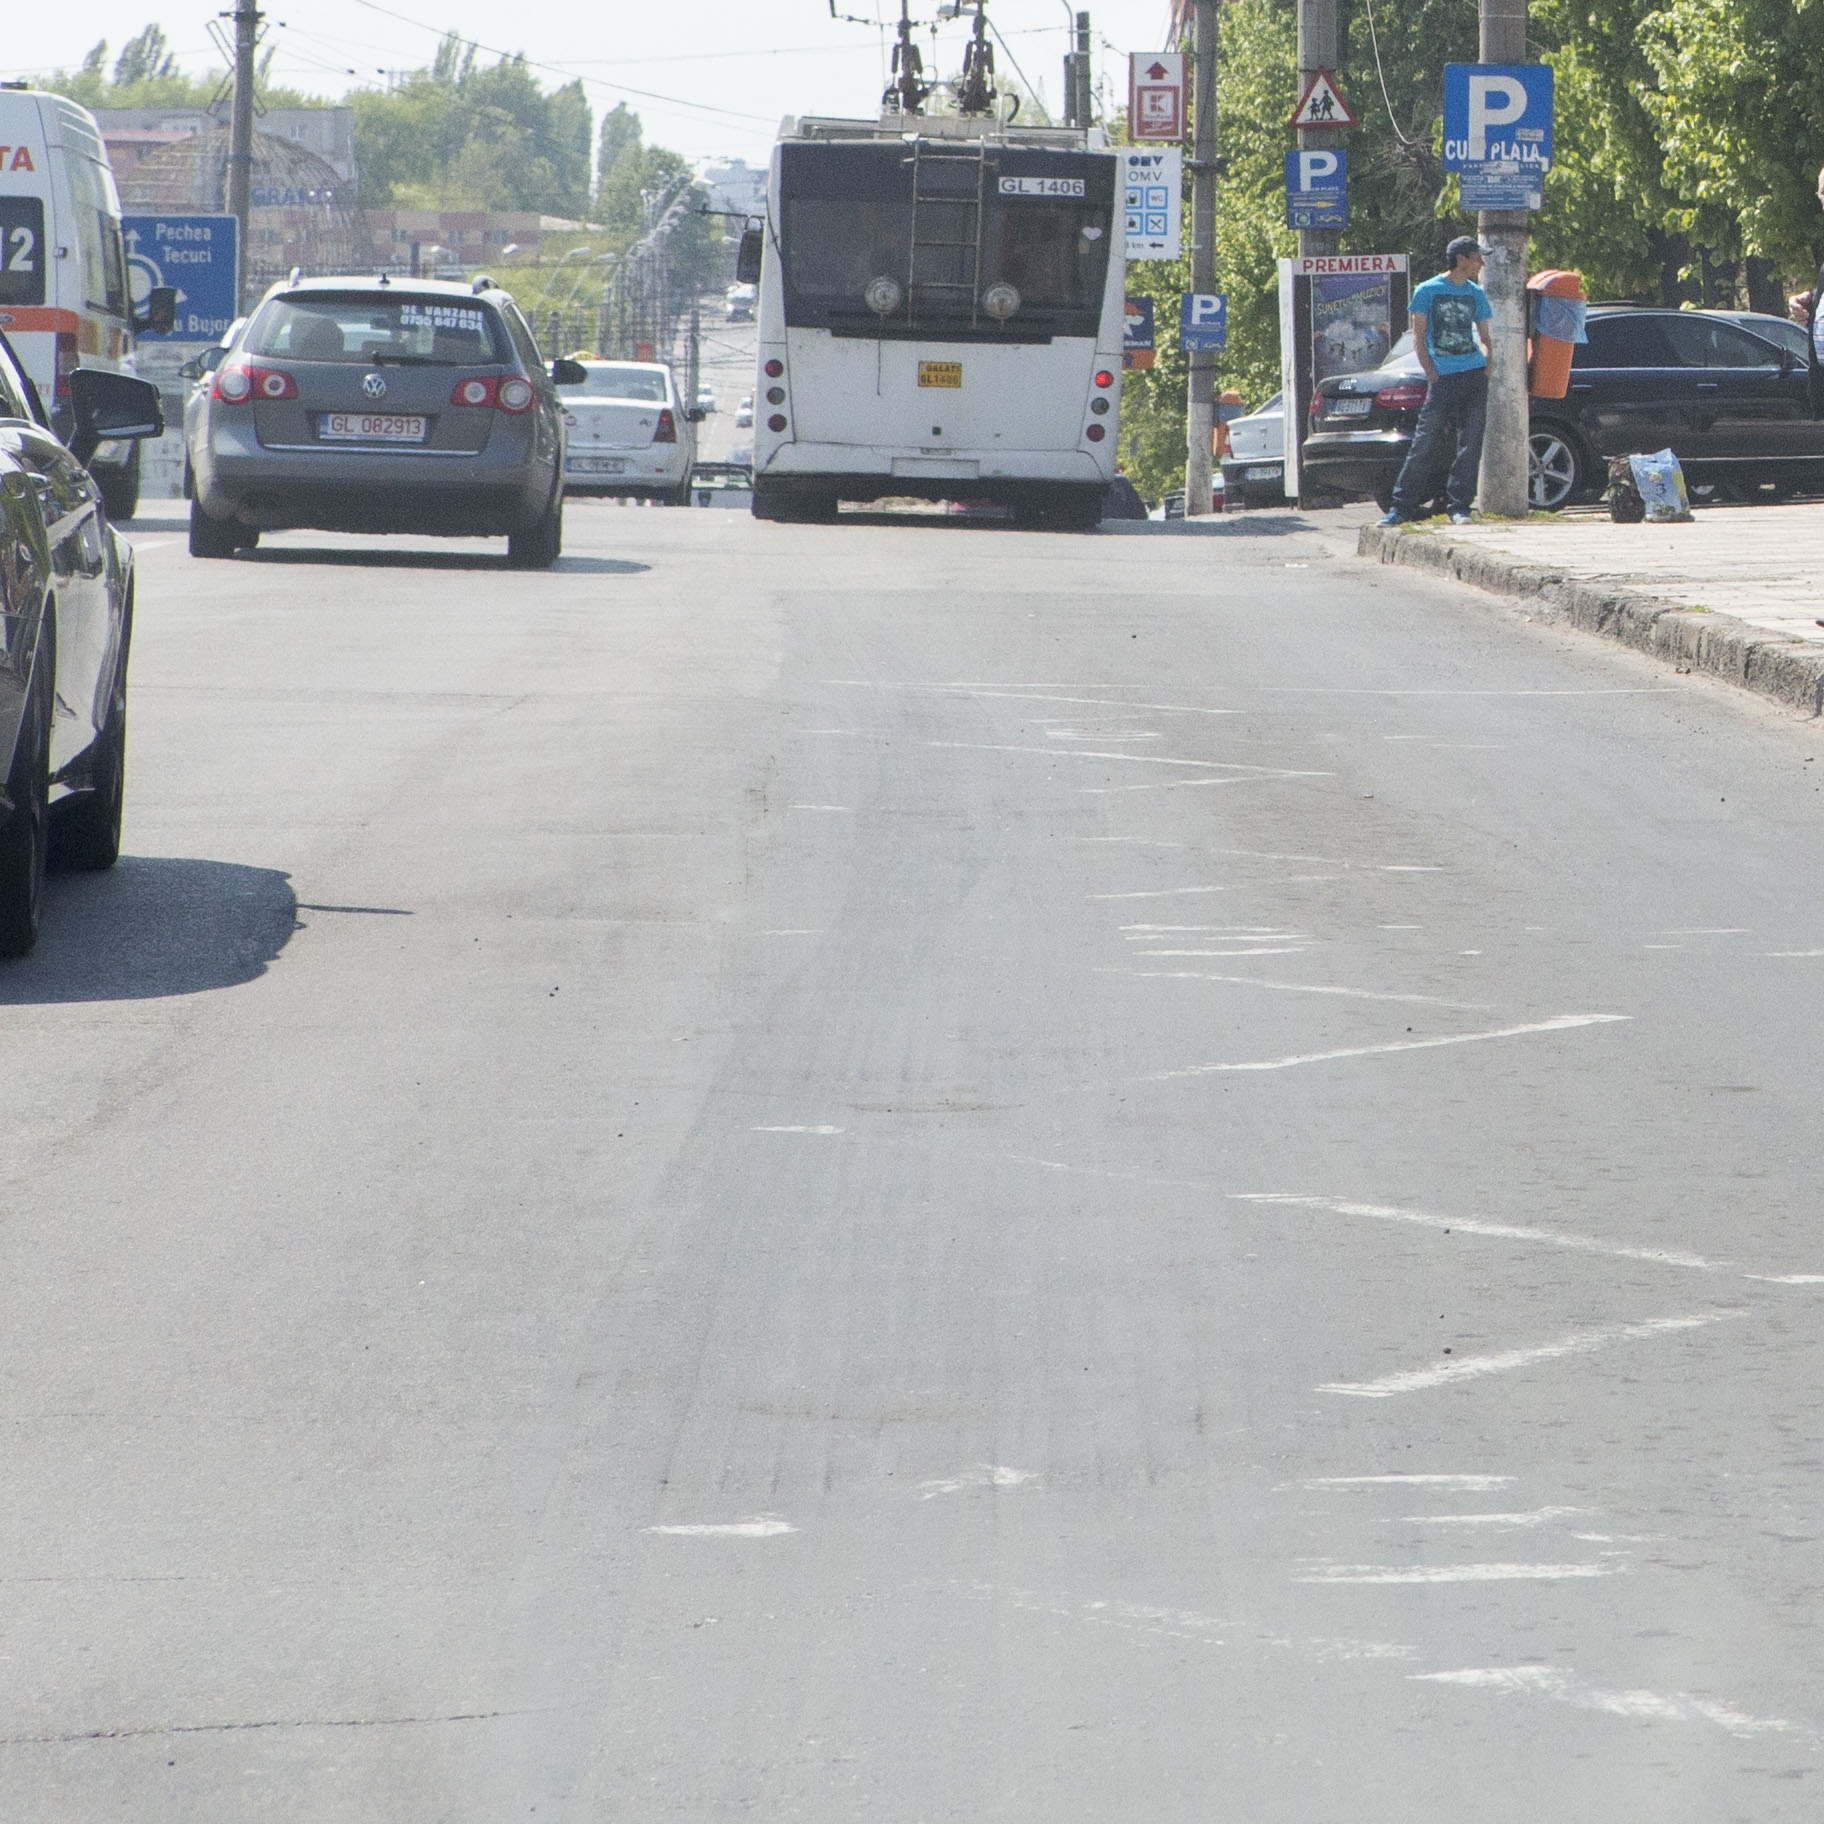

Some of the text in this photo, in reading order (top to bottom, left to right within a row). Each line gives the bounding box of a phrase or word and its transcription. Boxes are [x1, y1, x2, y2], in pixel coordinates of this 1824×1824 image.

[1468, 74, 1528, 161] P
[1445, 139, 1468, 161] CU
[1128, 171, 1163, 182] OMV
[1300, 150, 1338, 193] P
[1001, 178, 1083, 195] GL 1406
[1150, 194, 1164, 203] WC
[154, 223, 212, 241] Pechea
[162, 247, 212, 264] Tecuci
[1302, 256, 1397, 273] PREMIERA
[1191, 294, 1222, 326] P
[330, 416, 423, 436] GL 082913
